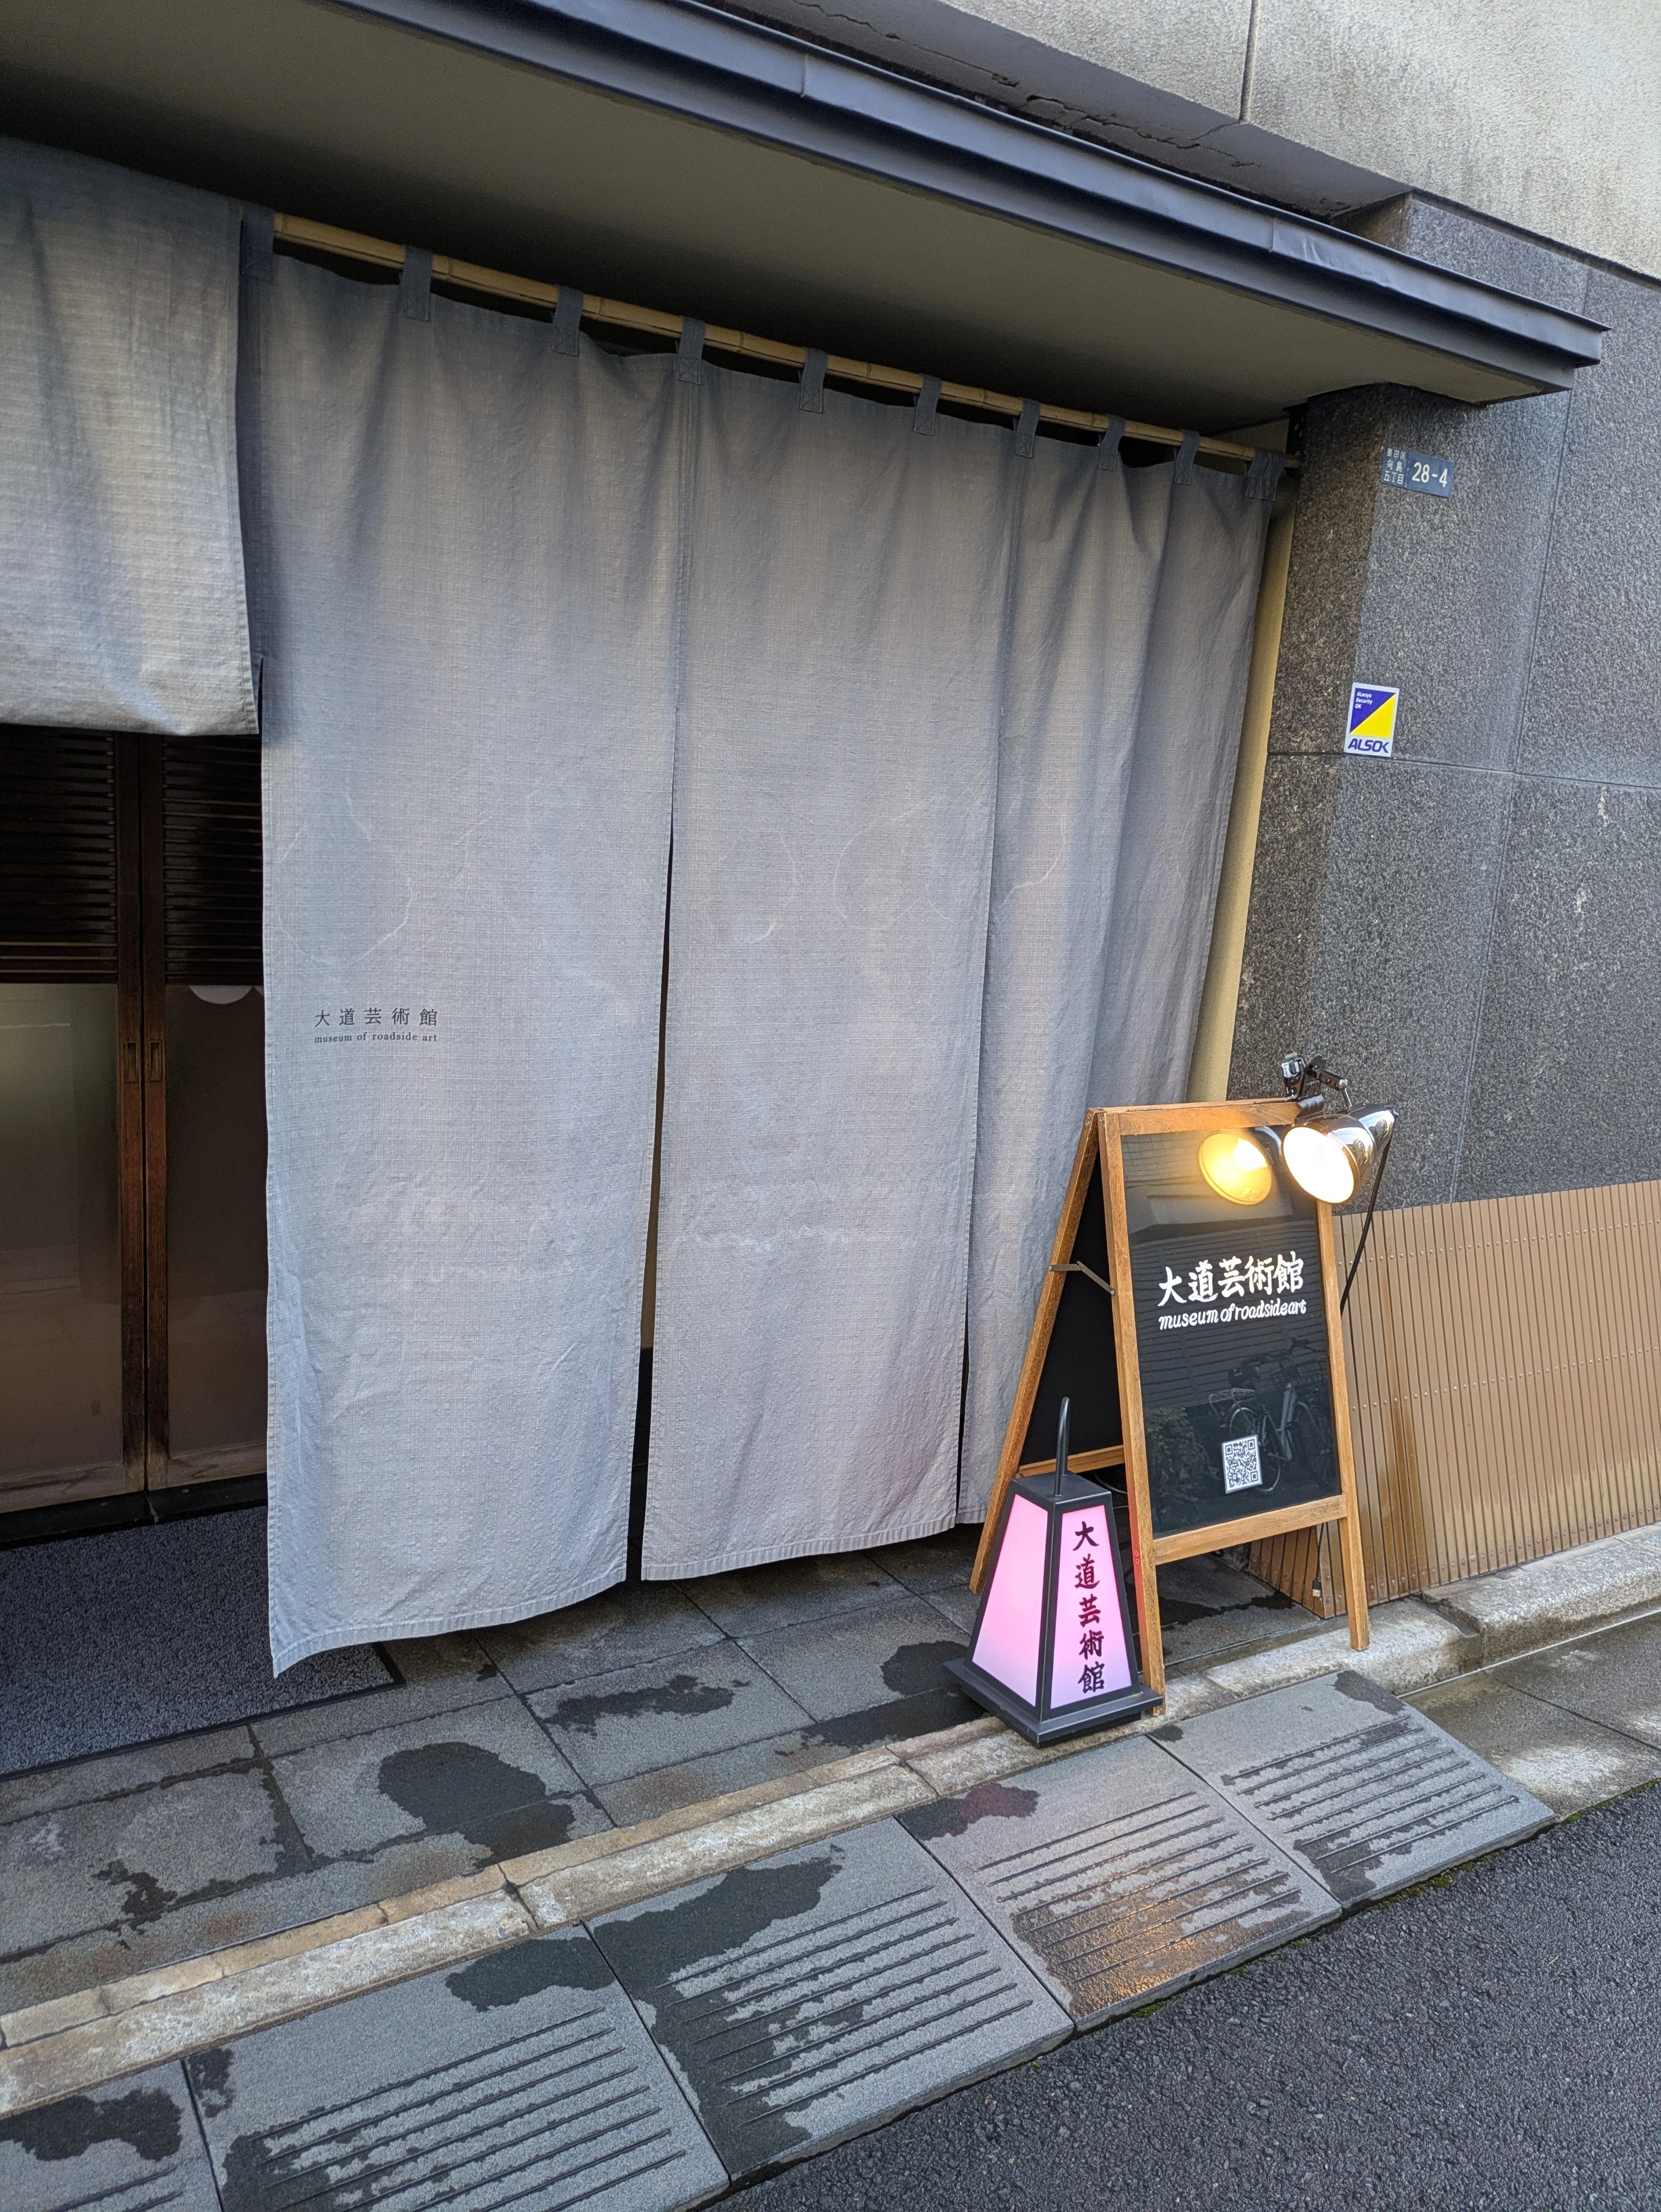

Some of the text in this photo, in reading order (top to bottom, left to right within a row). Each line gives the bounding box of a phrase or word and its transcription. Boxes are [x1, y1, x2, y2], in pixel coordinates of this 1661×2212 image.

[1386, 459, 1403, 472] 向島
[1412, 462, 1448, 487] 28-4
[1384, 470, 1404, 485] 五丁目
[1355, 697, 1373, 705] Security
[1347, 738, 1390, 753] ALSOK
[314, 1007, 438, 1028] 大道芸術館
[314, 1031, 437, 1043] museum of roadside art
[1157, 1250, 1304, 1307] 大道芸術館
[1158, 1309, 1219, 1330] museum
[1073, 1521, 1105, 1693] 大道芸術館
